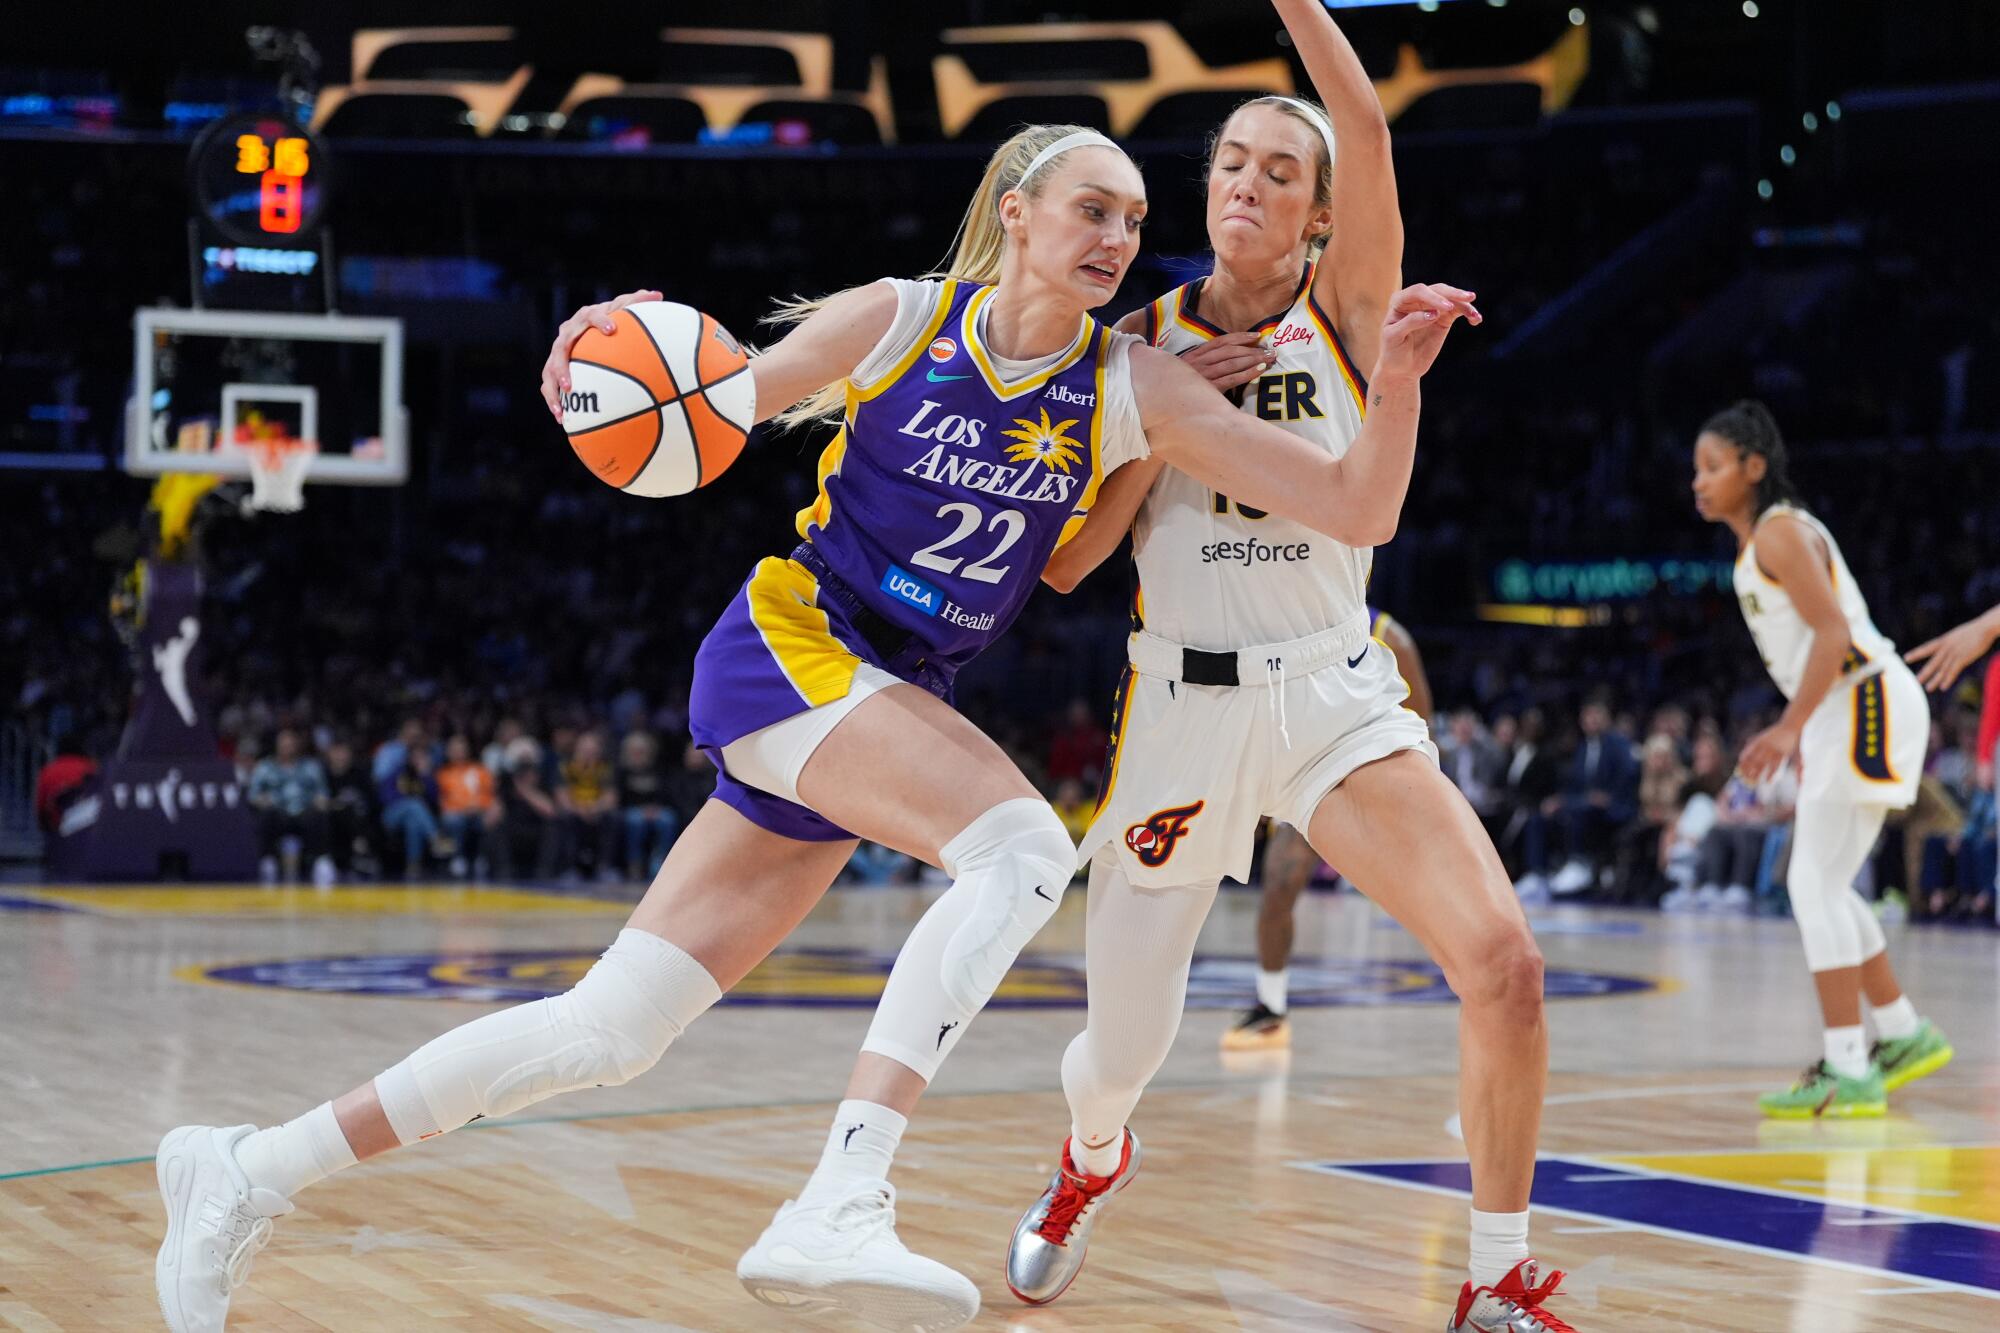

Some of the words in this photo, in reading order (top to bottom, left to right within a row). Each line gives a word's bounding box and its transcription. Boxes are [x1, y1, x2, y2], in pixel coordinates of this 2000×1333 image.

[1273, 324, 1315, 346] Lilly
[1043, 384, 1096, 408] Albert
[902, 444, 1079, 504] ANGELES
[909, 502, 1027, 585] 22
[1201, 537, 1311, 567] saesforce
[889, 574, 933, 608] UCLA
[940, 600, 996, 632] Health
